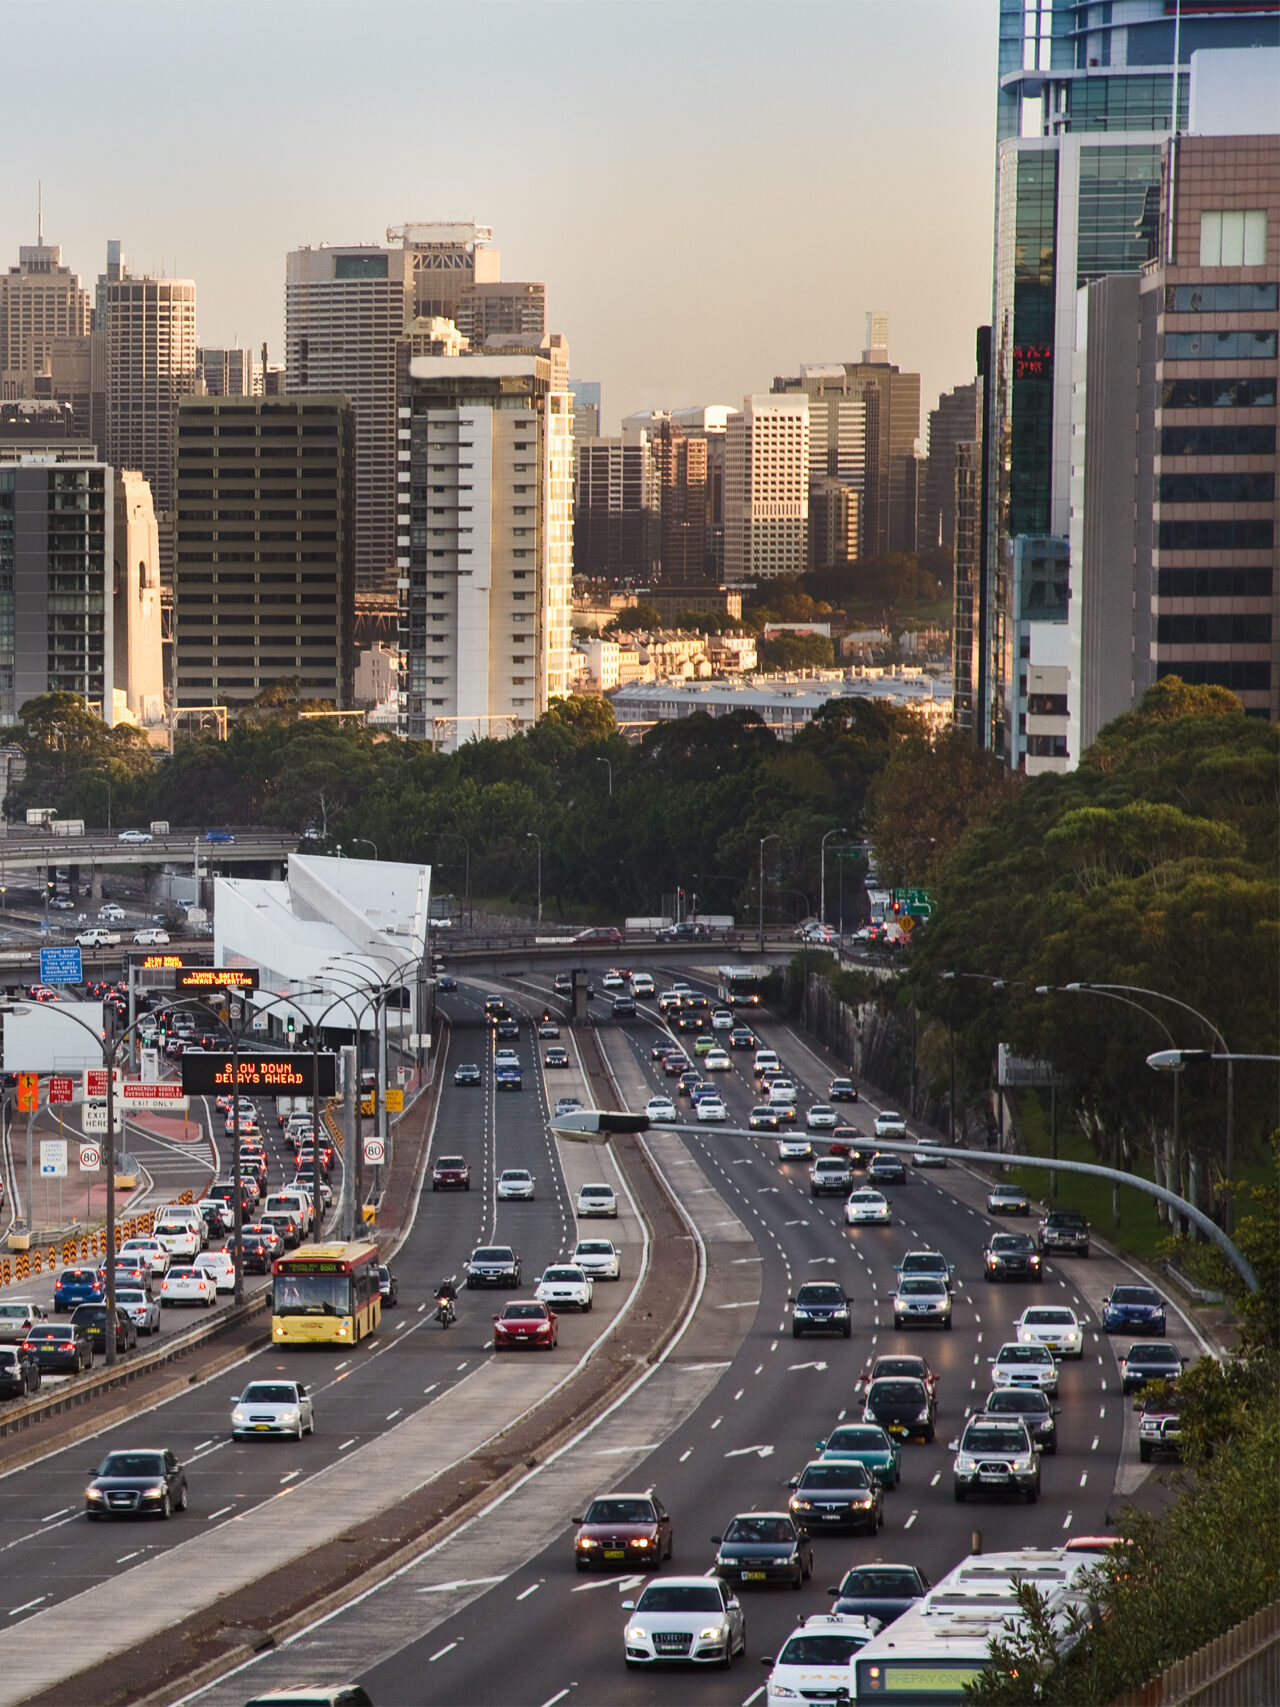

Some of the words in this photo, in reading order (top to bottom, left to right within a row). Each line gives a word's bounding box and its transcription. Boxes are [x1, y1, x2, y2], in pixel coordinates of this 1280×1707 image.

[261, 1064, 292, 1073] DOWN
[265, 1074, 304, 1083] AHEAD
[83, 1153, 96, 1162] 80
[887, 1674, 936, 1683] PREPAY
